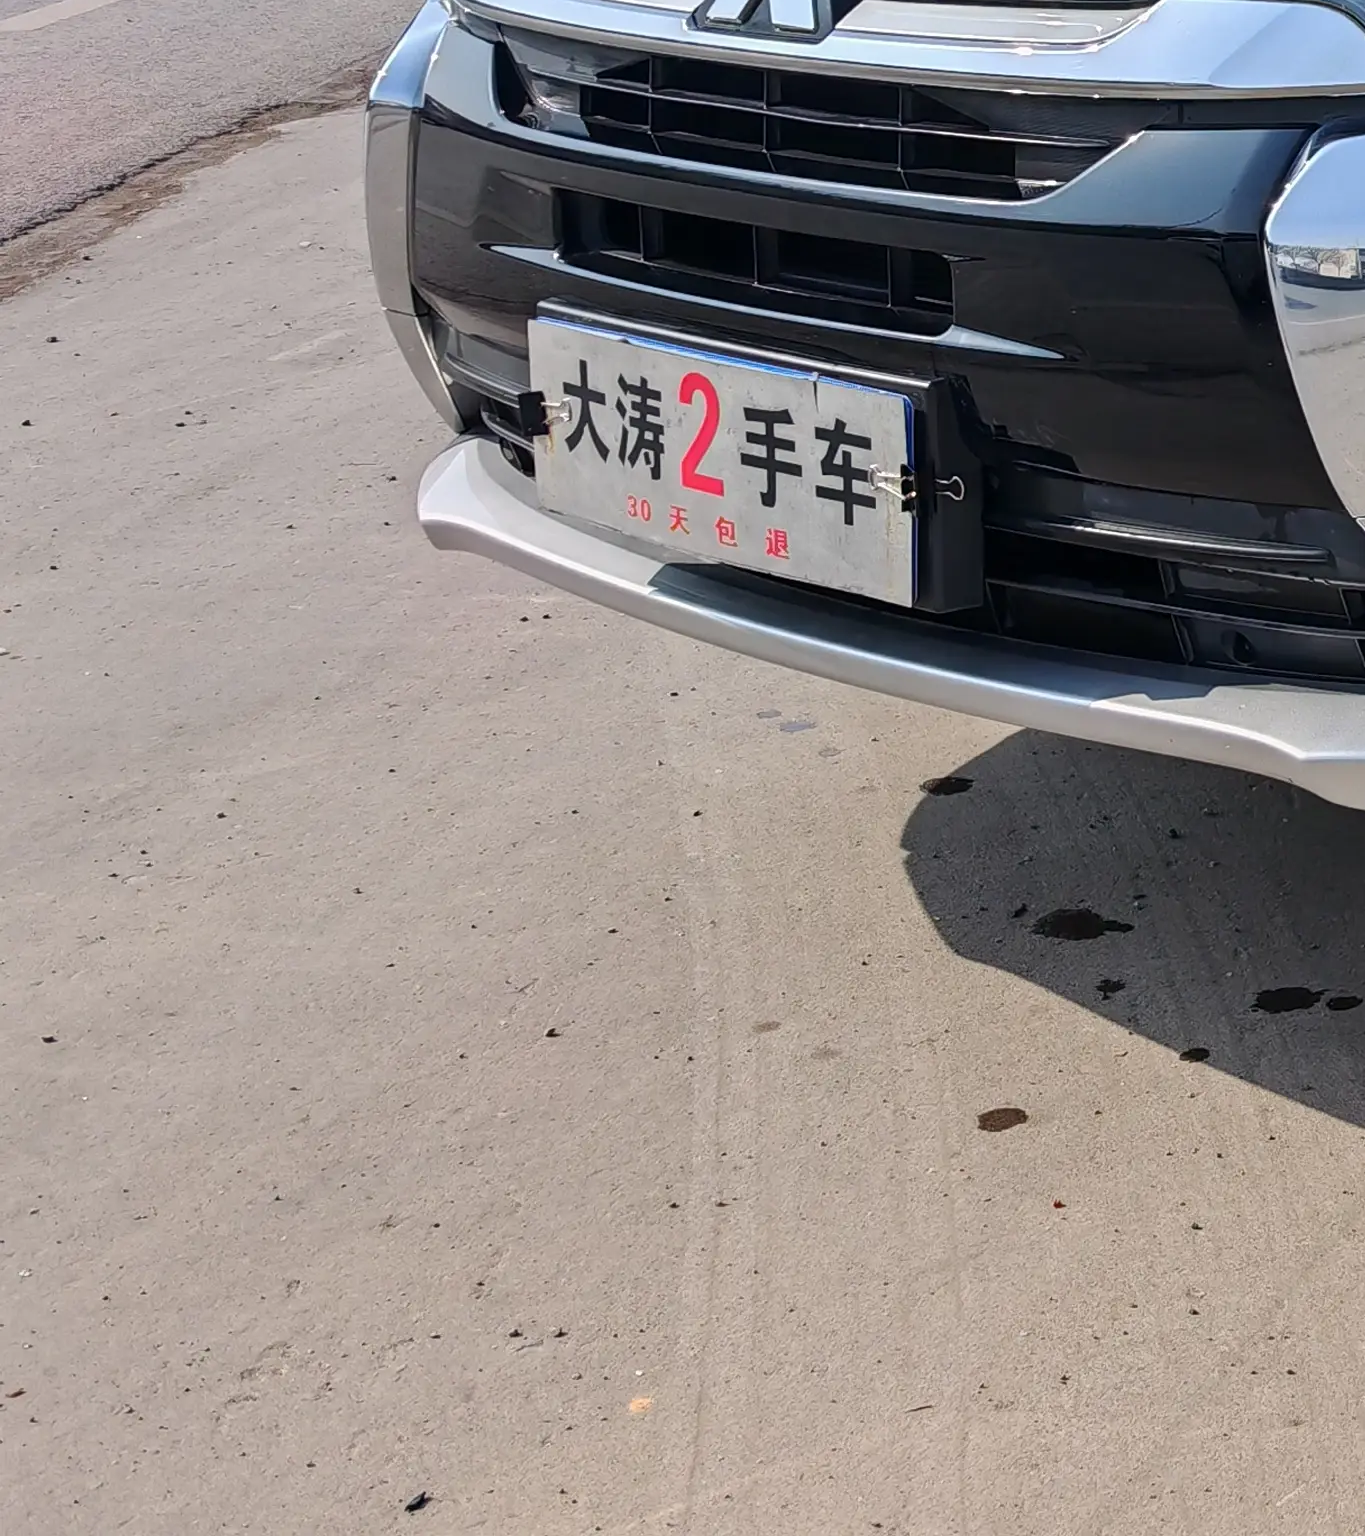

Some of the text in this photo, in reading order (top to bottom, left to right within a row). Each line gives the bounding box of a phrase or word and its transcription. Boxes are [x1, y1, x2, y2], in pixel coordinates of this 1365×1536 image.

[562, 358, 877, 526] 大涛2手车
[626, 494, 791, 560] 30天包退
